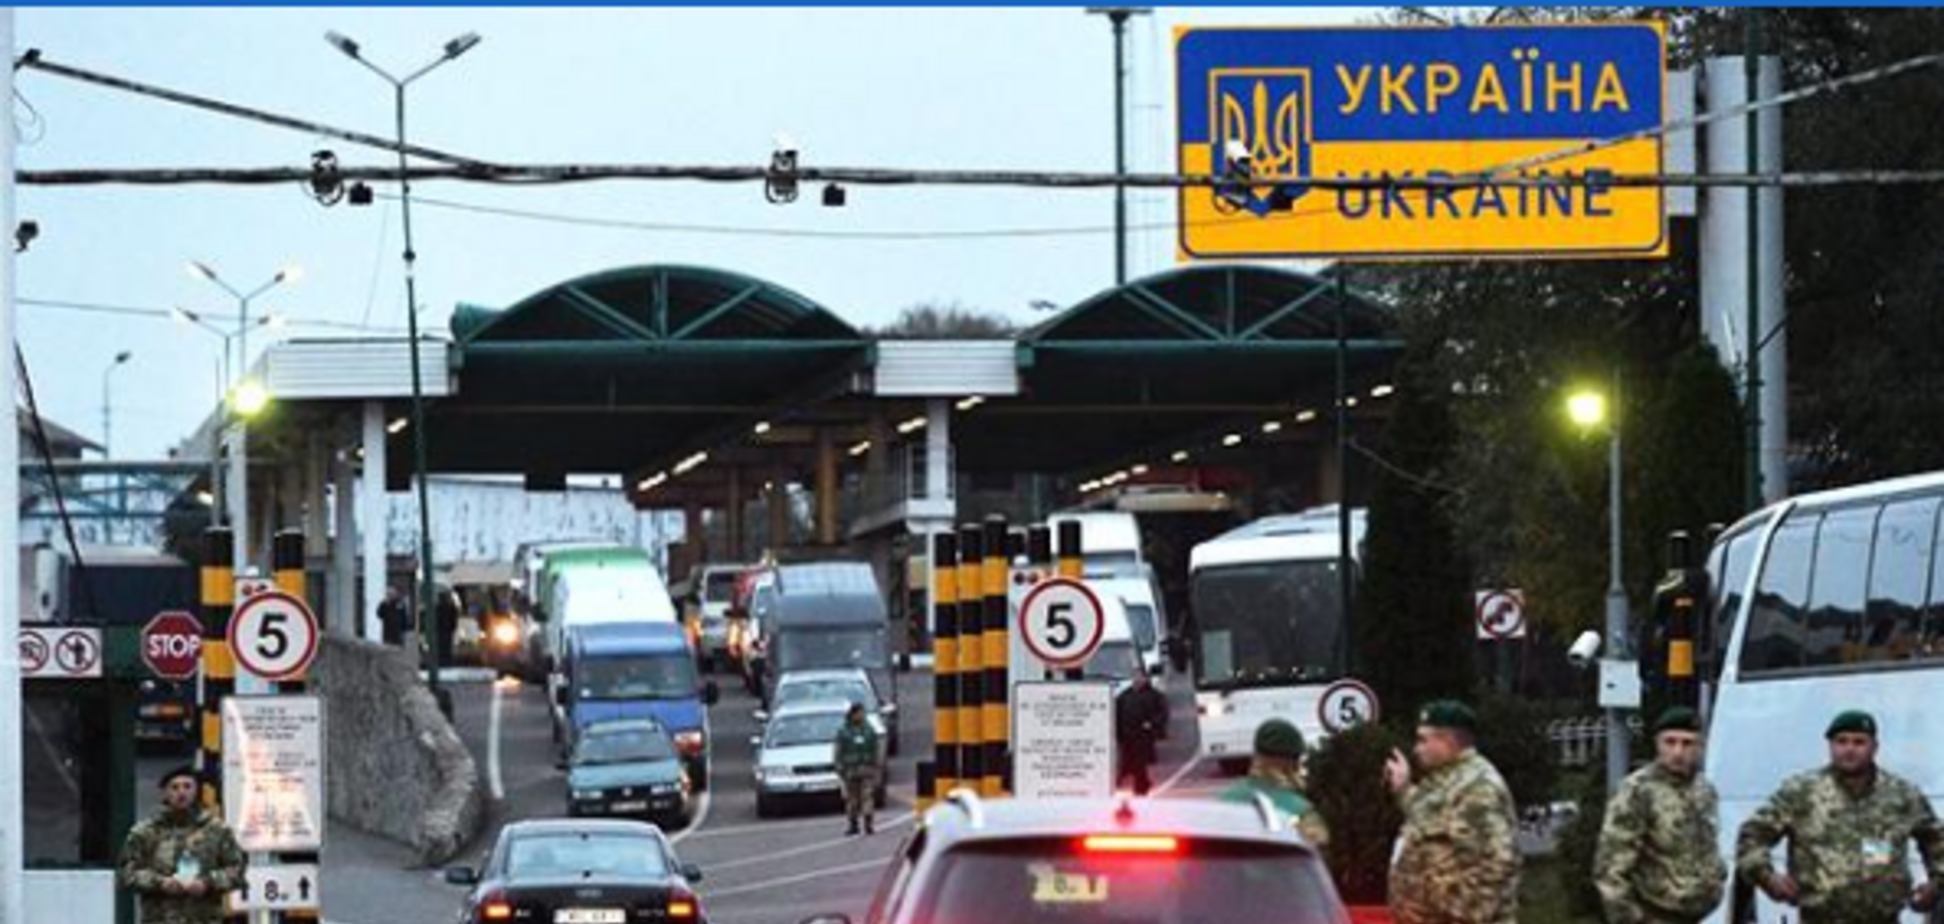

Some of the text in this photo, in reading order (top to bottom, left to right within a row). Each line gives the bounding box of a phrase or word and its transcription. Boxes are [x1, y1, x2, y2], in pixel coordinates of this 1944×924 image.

[1335, 48, 1630, 114] УКРАЇНА
[1335, 167, 1614, 219] UKRAINE
[149, 633, 201, 659] STOP
[256, 612, 288, 660] 5
[1046, 602, 1076, 649] 5
[1339, 697, 1357, 724] 5
